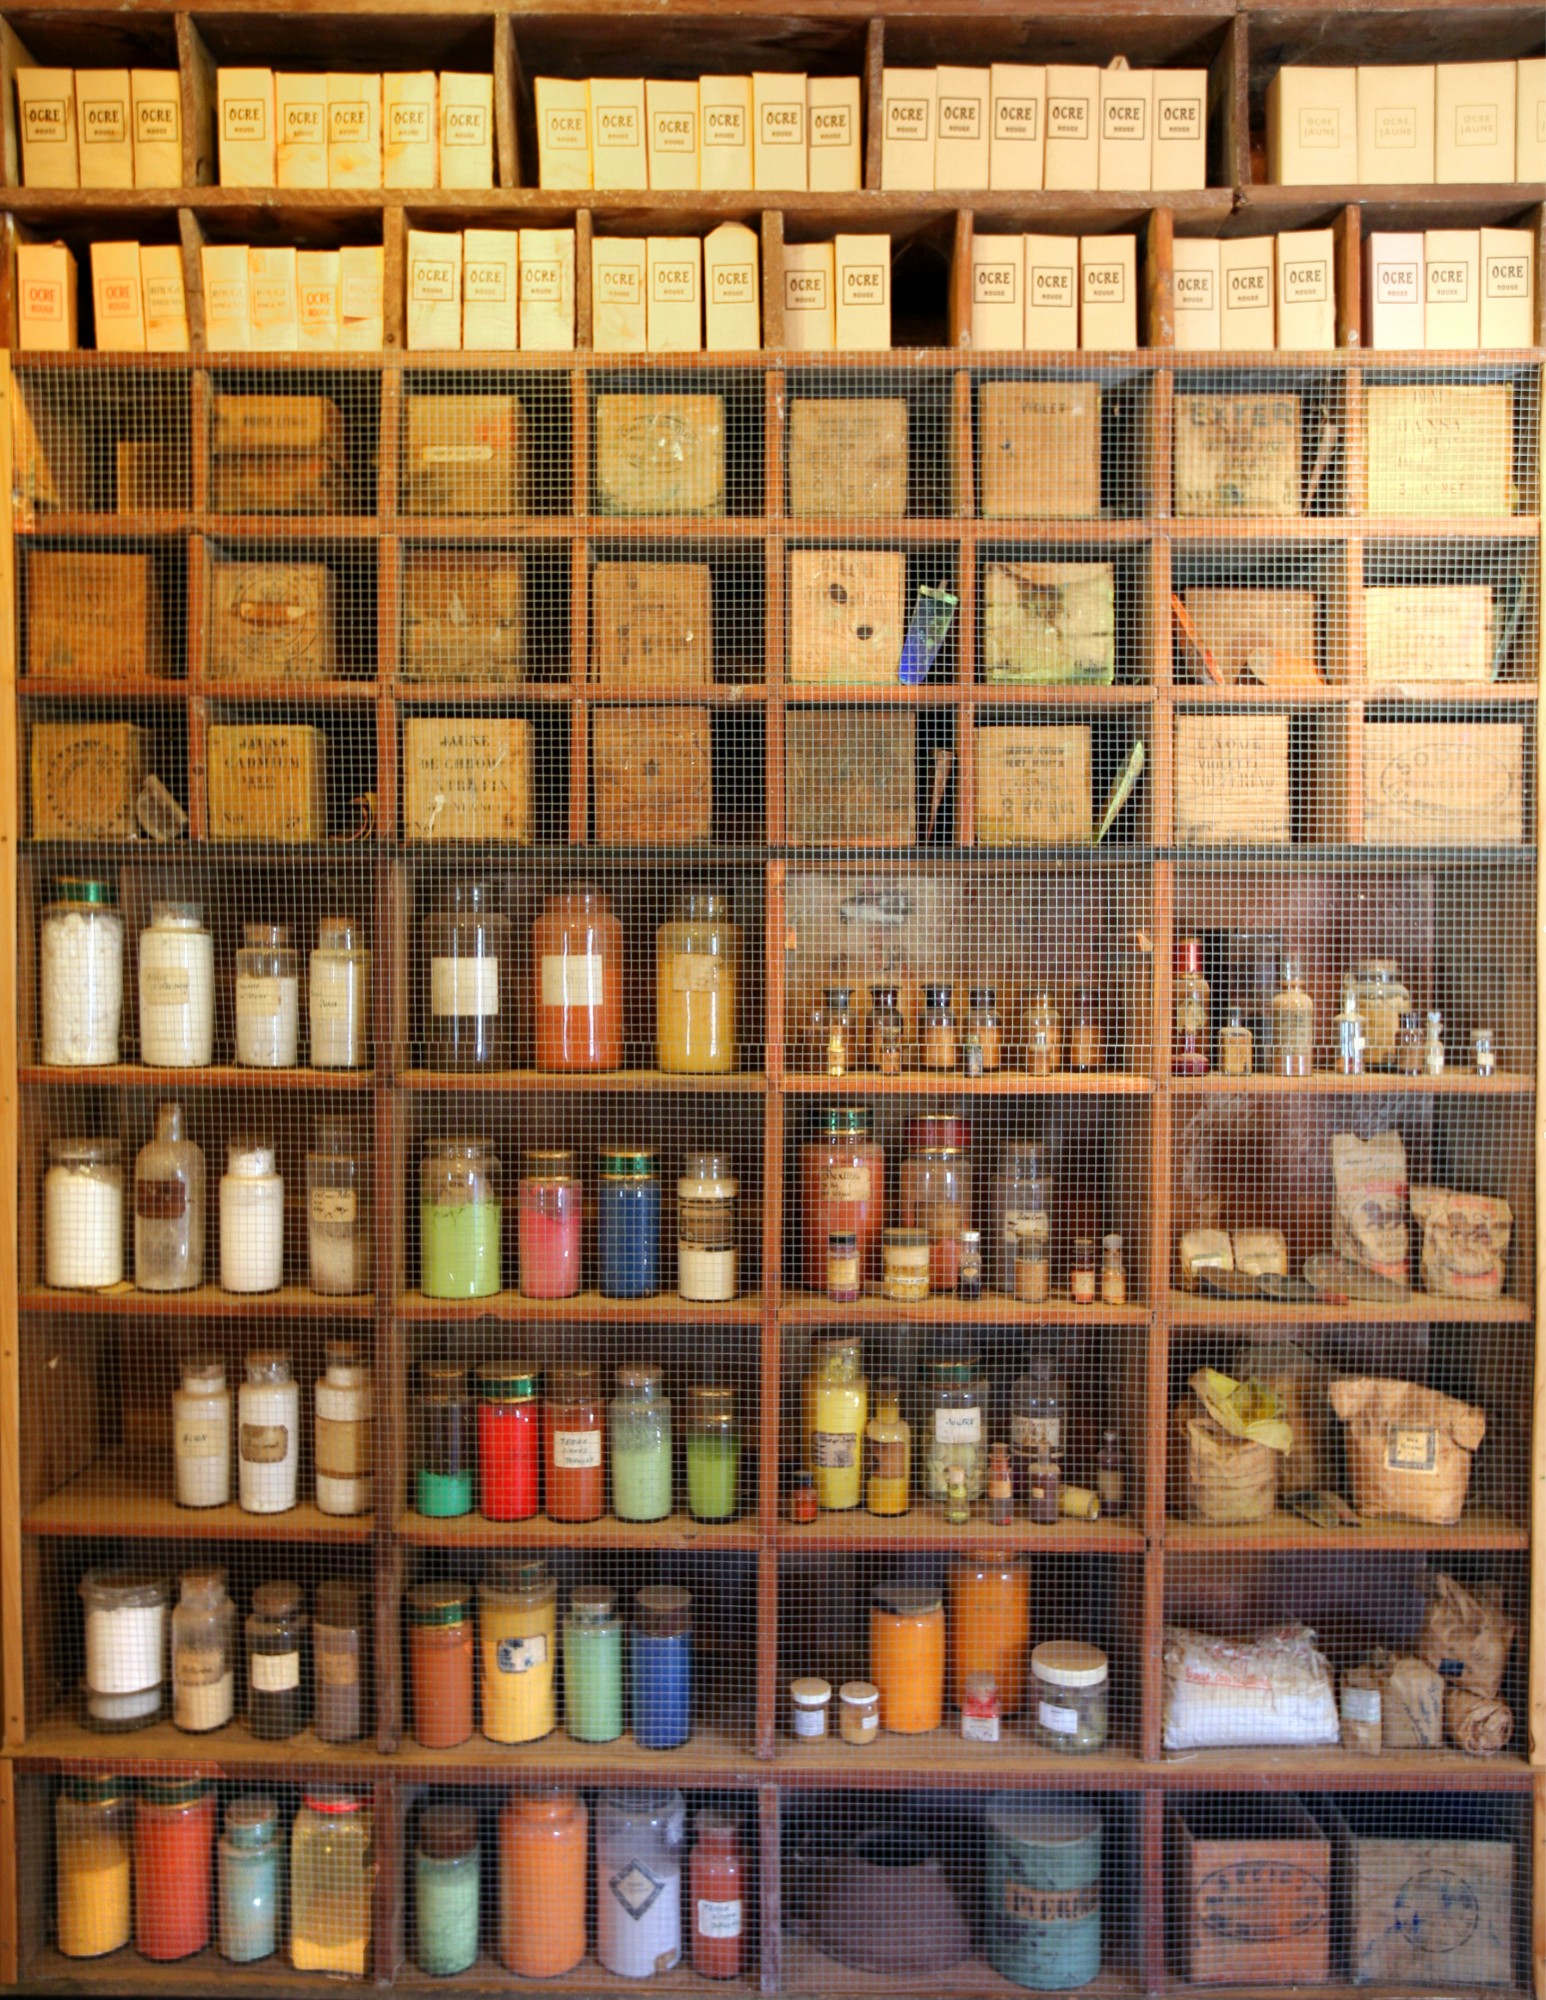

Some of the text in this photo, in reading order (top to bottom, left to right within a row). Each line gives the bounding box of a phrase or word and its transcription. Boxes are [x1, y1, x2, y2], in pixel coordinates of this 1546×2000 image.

[30, 109, 60, 123] OCRE
[89, 109, 119, 124] OCRE
[141, 109, 172, 123] OCRE
[229, 107, 260, 121] OCRE
[289, 111, 319, 125] OCRE
[335, 111, 365, 124] OCRE
[395, 111, 425, 125] OCRE
[767, 112, 797, 125] OCRE
[892, 107, 923, 121] OCRE
[944, 106, 975, 120] OCRE
[1001, 107, 1031, 120] OCRE
[1052, 107, 1083, 120] OCRE
[1109, 107, 1140, 120] OCRE
[1164, 107, 1195, 121] OCRE
[450, 113, 481, 127] OCRE
[552, 117, 582, 131] OCRE
[603, 114, 633, 127] OCRE
[709, 113, 740, 127] OCRE
[815, 115, 846, 128] OCRE
[659, 121, 689, 134] OCRE
[417, 270, 449, 283] OCRE
[470, 271, 501, 284] OCRE
[525, 269, 556, 282] OCRE
[659, 270, 689, 283] OCRE
[717, 271, 748, 284] OCRE
[979, 270, 1010, 284] OCRE
[1290, 270, 1321, 284] OCRE
[1432, 270, 1463, 284] OCRE
[1492, 265, 1523, 278] OCRE
[604, 272, 635, 286] OCRE
[790, 278, 820, 291] OCRE
[849, 273, 879, 286] OCRE
[1037, 276, 1068, 289] OCRE
[1088, 272, 1119, 285] OCRE
[1178, 278, 1209, 292] OCRE
[1232, 276, 1264, 290] OCRE
[1383, 272, 1413, 285] OCRE
[30, 288, 55, 302] OCRE
[106, 287, 131, 300] OCRE
[307, 291, 331, 304] OCRE
[225, 757, 299, 769] CADMIUM
